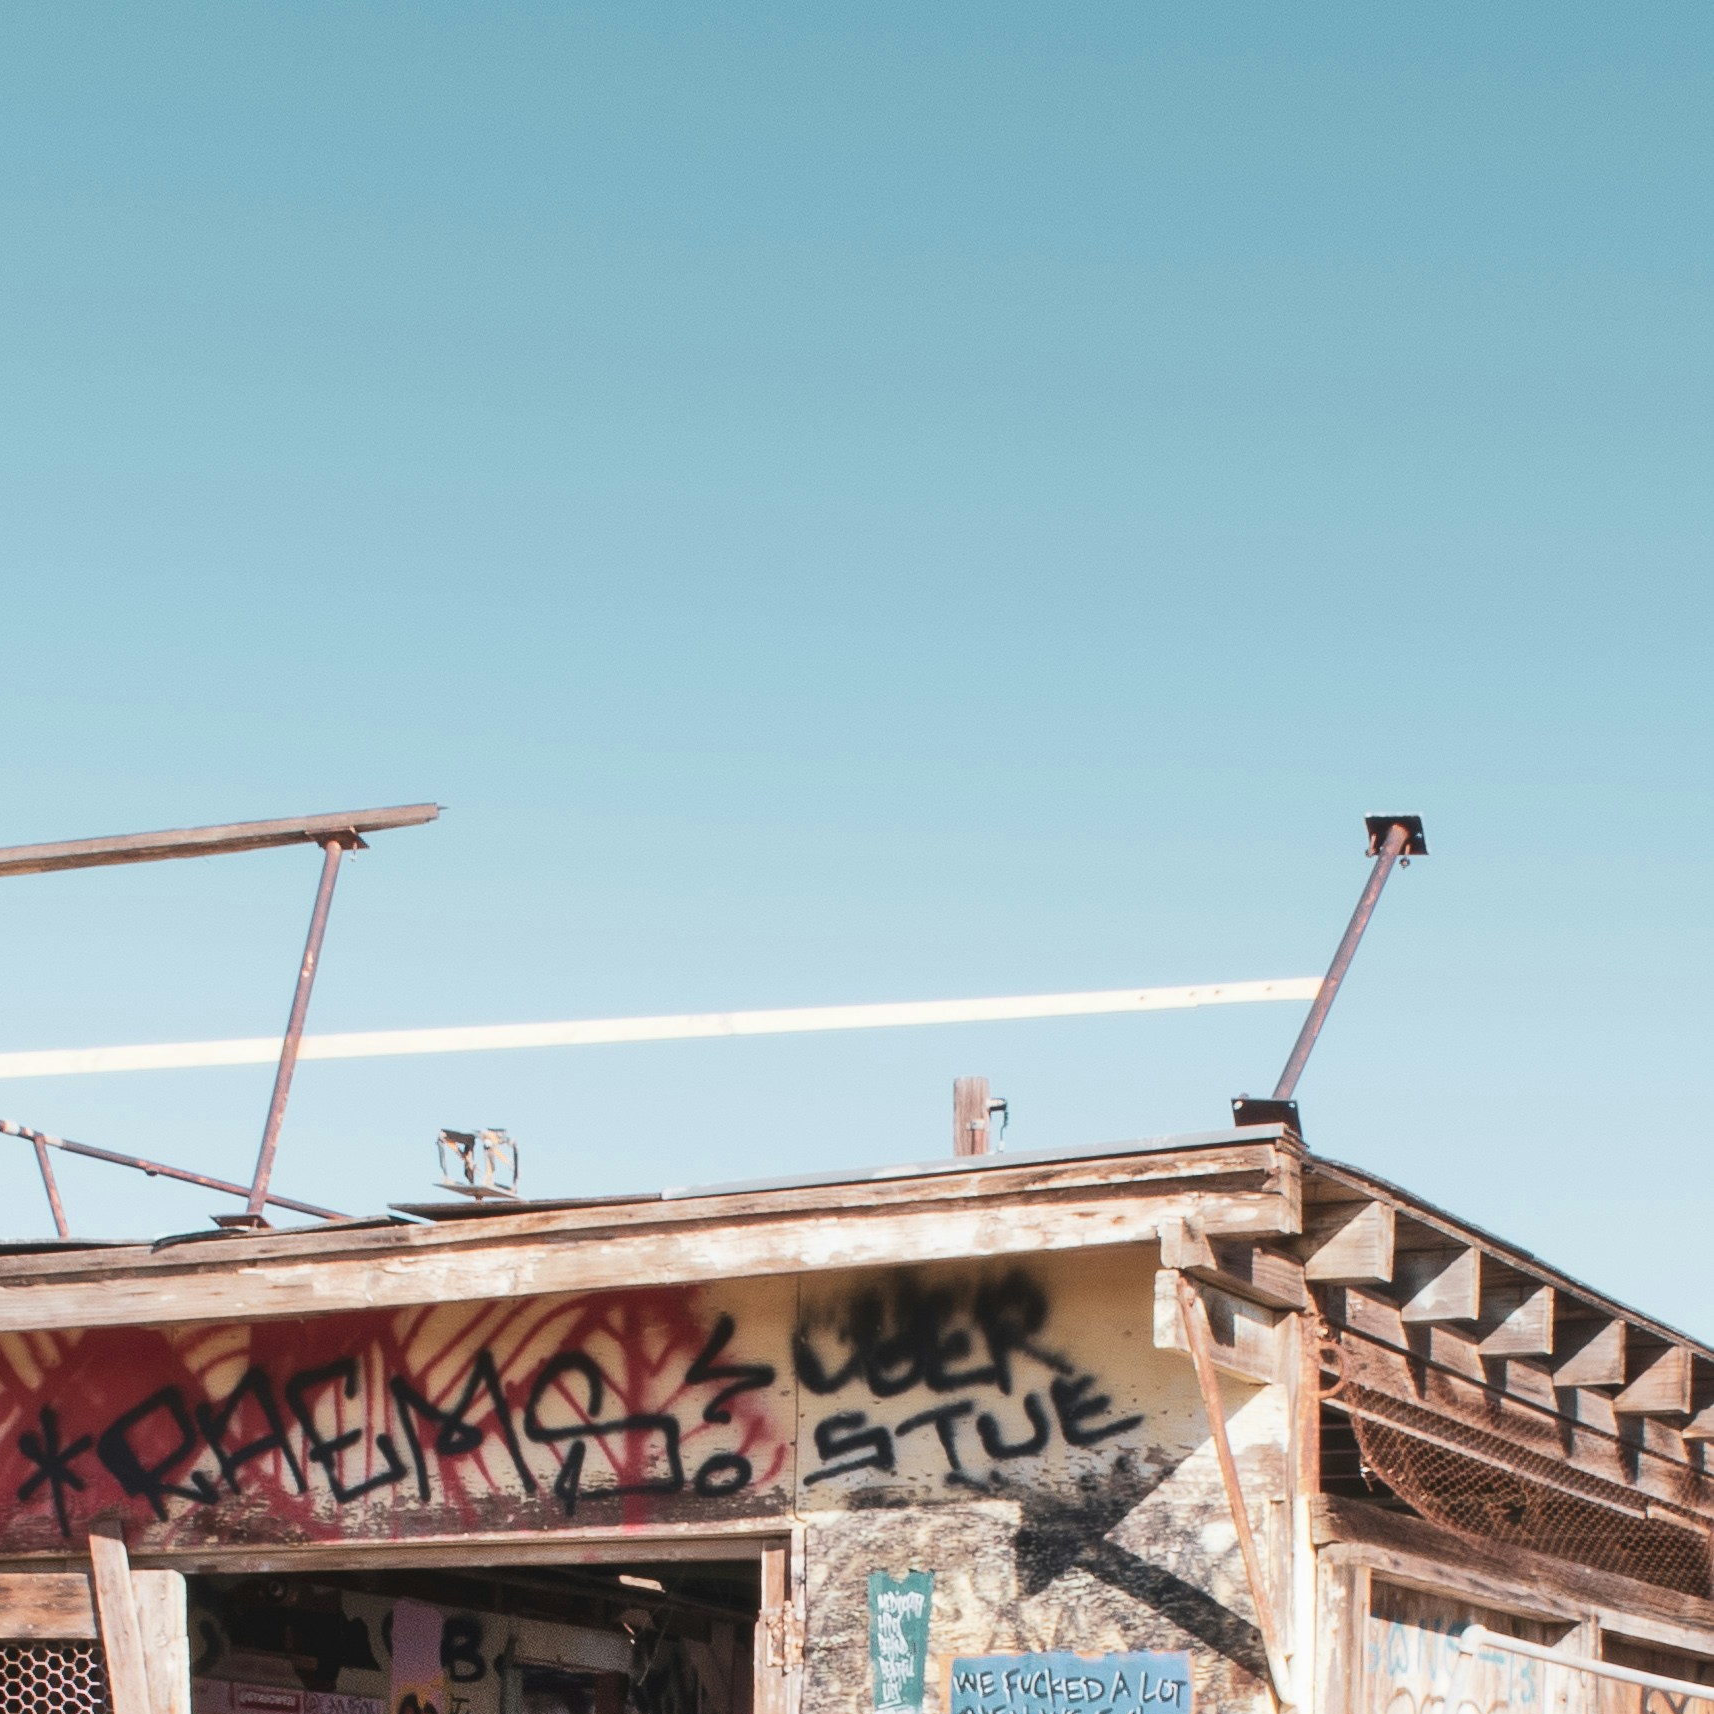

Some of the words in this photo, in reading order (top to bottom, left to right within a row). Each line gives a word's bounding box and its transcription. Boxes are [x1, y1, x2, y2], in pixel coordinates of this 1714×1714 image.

[953, 1671, 997, 1698] WE
[1002, 1667, 1105, 1707] FUCKED
[1109, 1670, 1131, 1704] A
[1140, 1671, 1188, 1708] LOT
